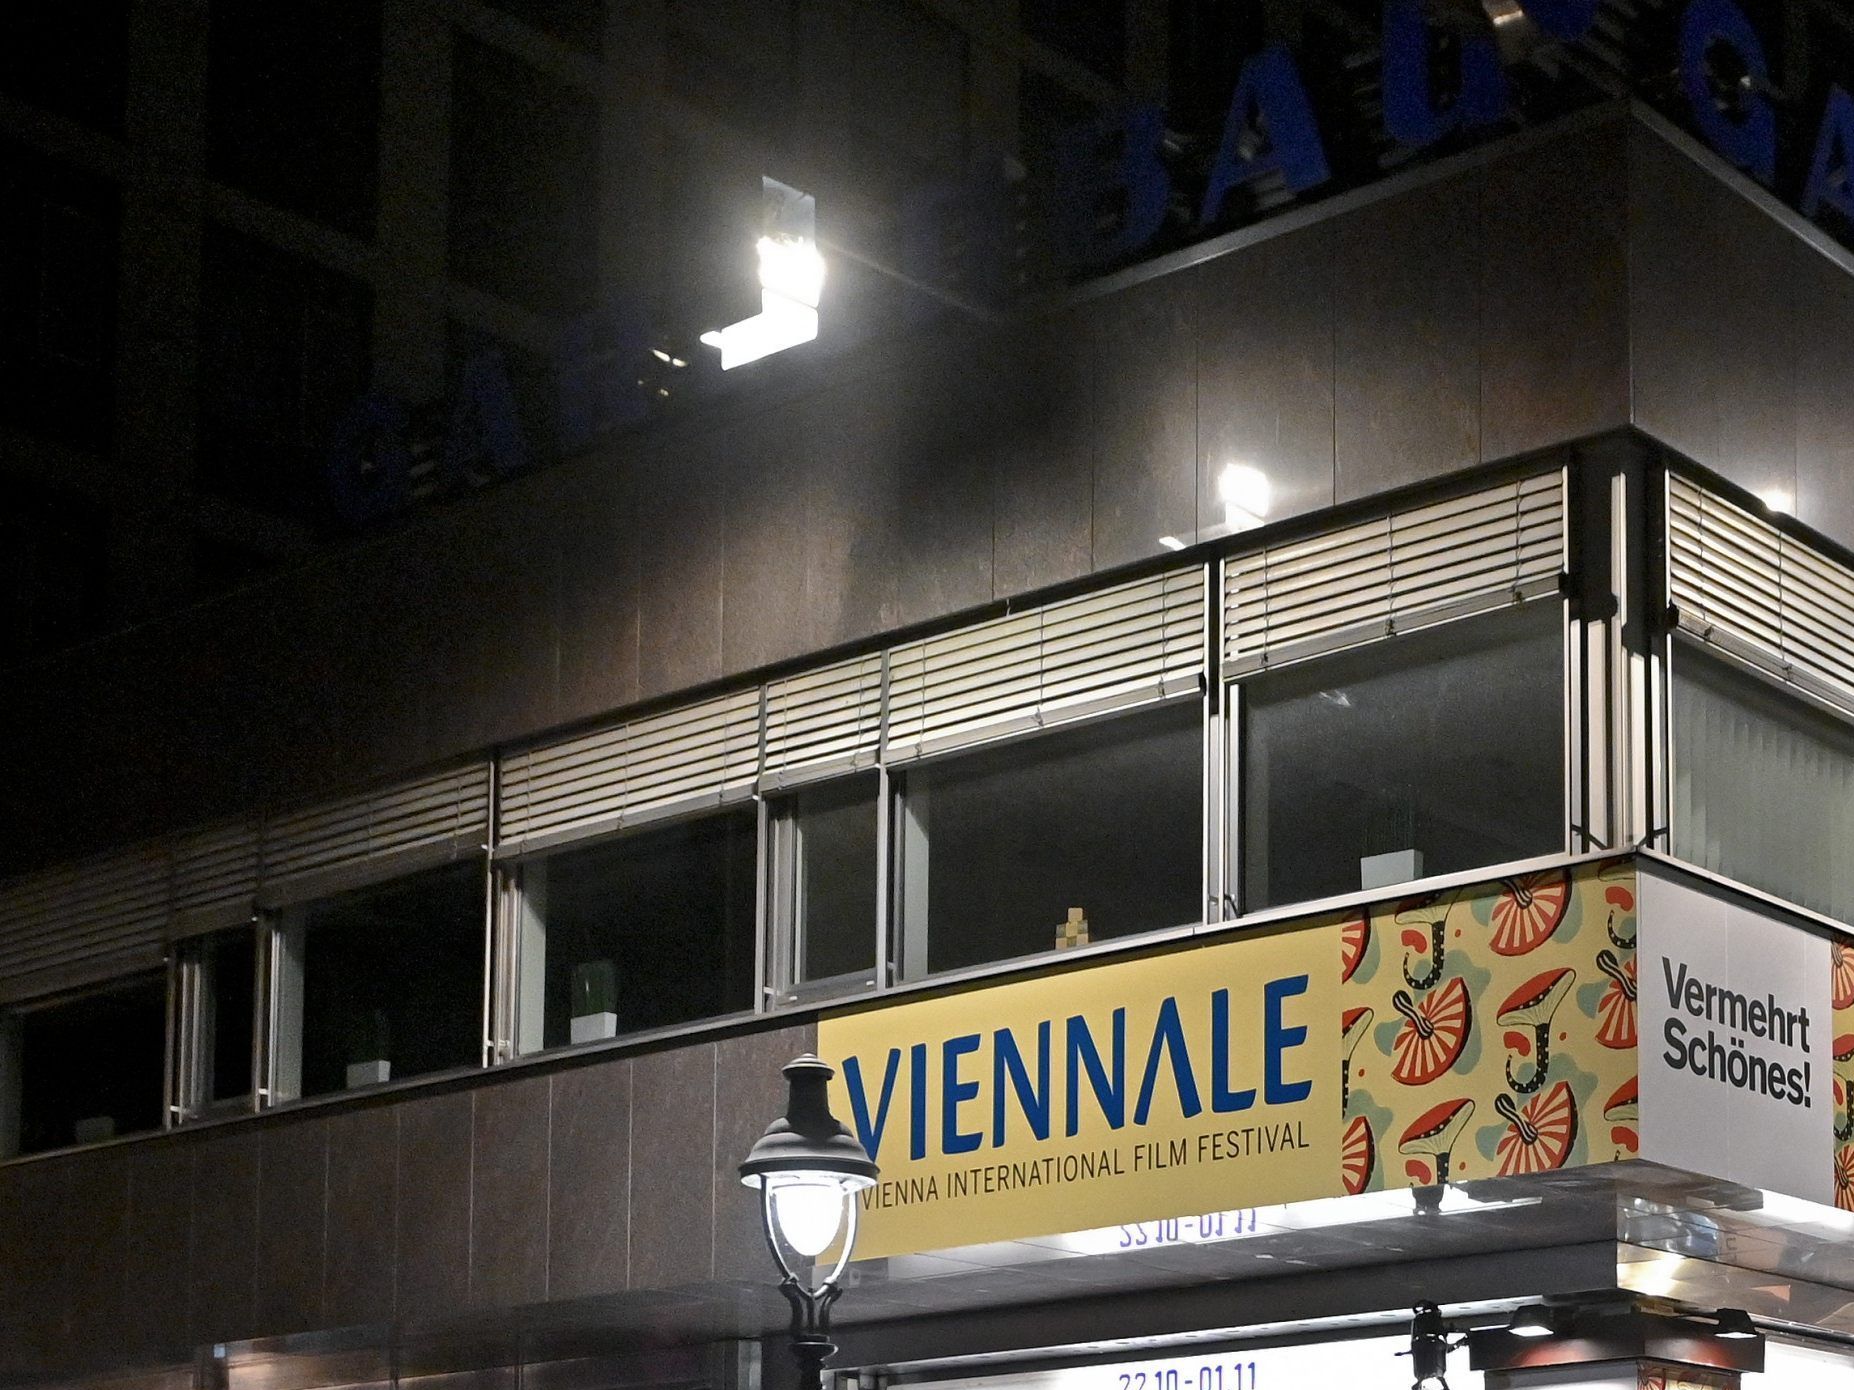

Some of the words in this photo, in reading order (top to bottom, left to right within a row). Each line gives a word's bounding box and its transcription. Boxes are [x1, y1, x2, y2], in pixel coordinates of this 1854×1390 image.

[1662, 956, 1810, 1053] Vermehrt
[842, 975, 1312, 1161] VIENNALE
[1663, 1017, 1811, 1108] Schönes!
[863, 1177, 939, 1212] VIENNA
[947, 1148, 1125, 1198] INTERNATIONAL
[1134, 1138, 1188, 1173] FILM
[1198, 1121, 1310, 1163] FESTIVAL
